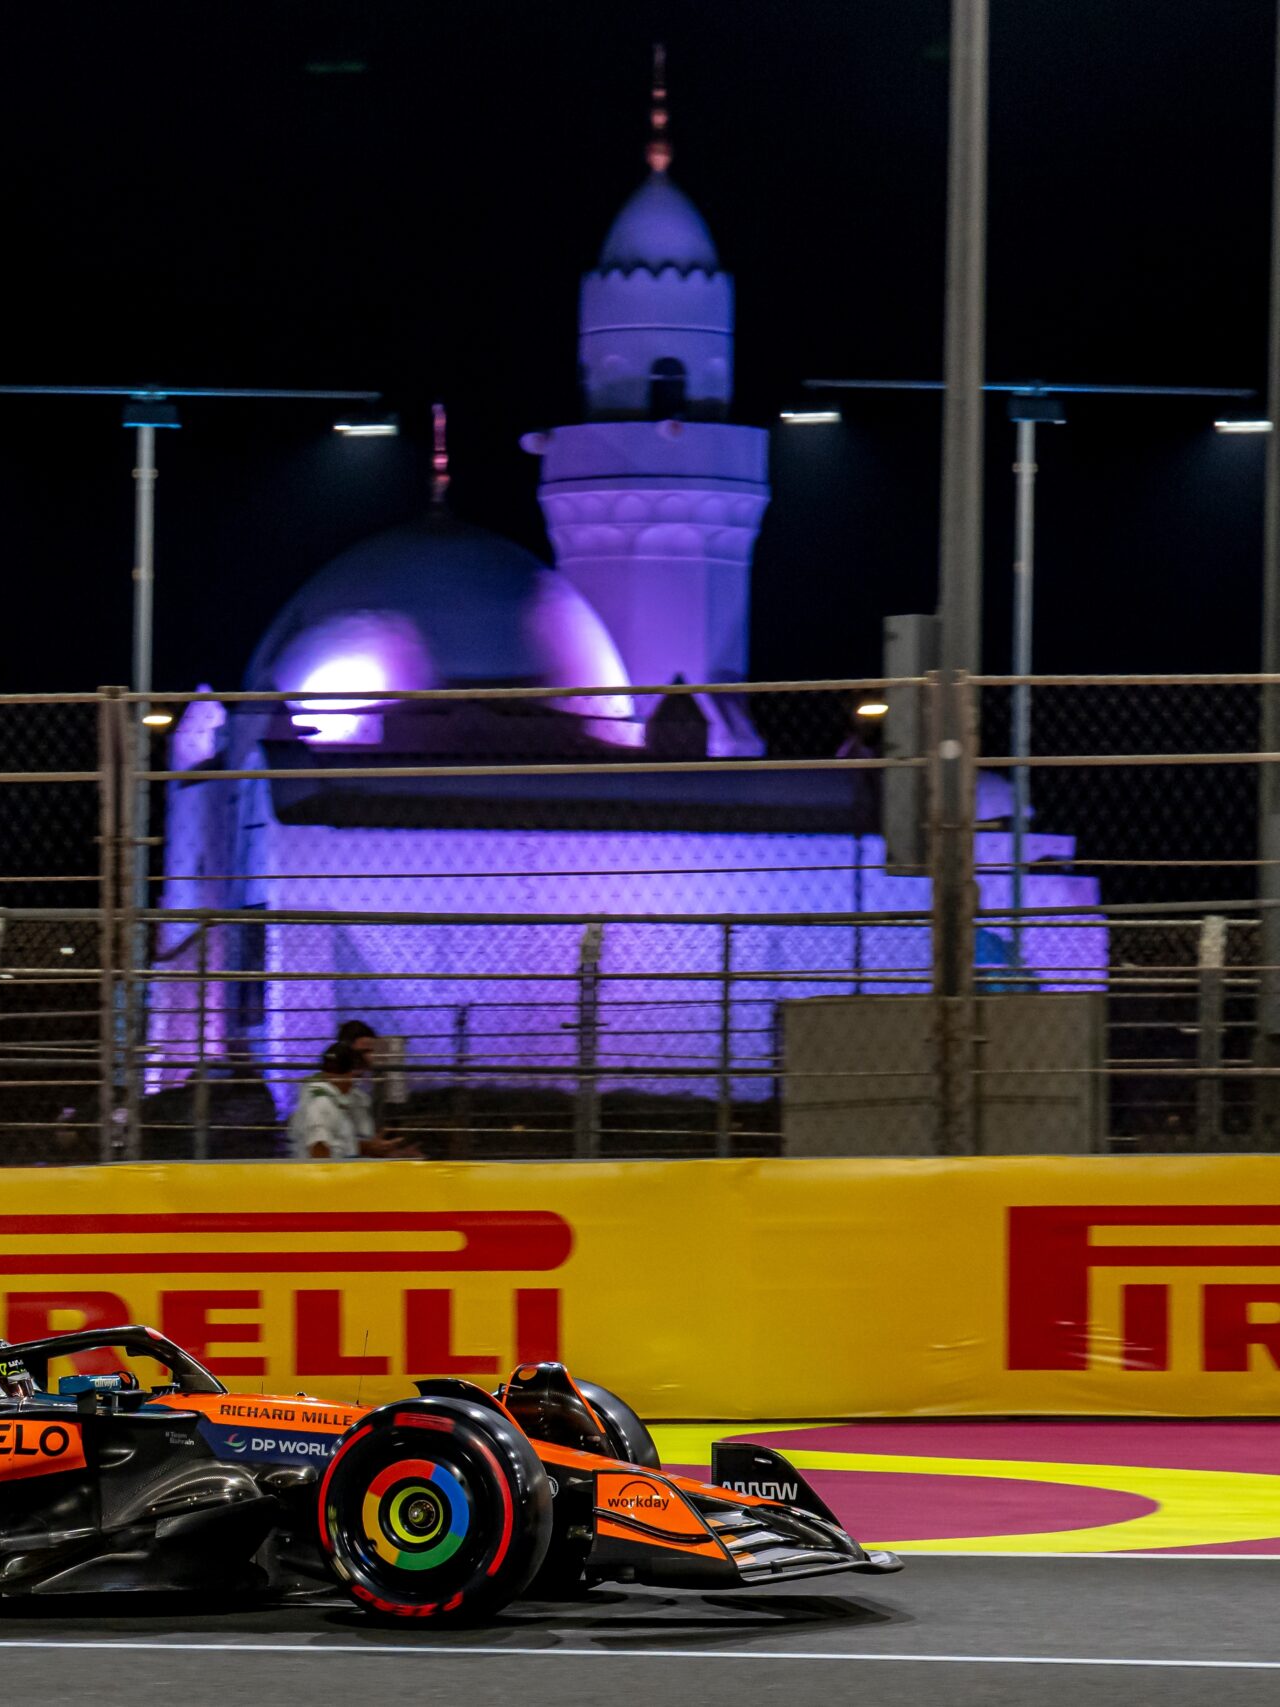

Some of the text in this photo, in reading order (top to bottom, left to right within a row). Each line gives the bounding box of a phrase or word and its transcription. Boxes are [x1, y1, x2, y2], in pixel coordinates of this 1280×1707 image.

[220, 1404, 354, 1427] RICHARD MILLE
[251, 1438, 328, 1457] DP WORL
[608, 1495, 669, 1511] workday
